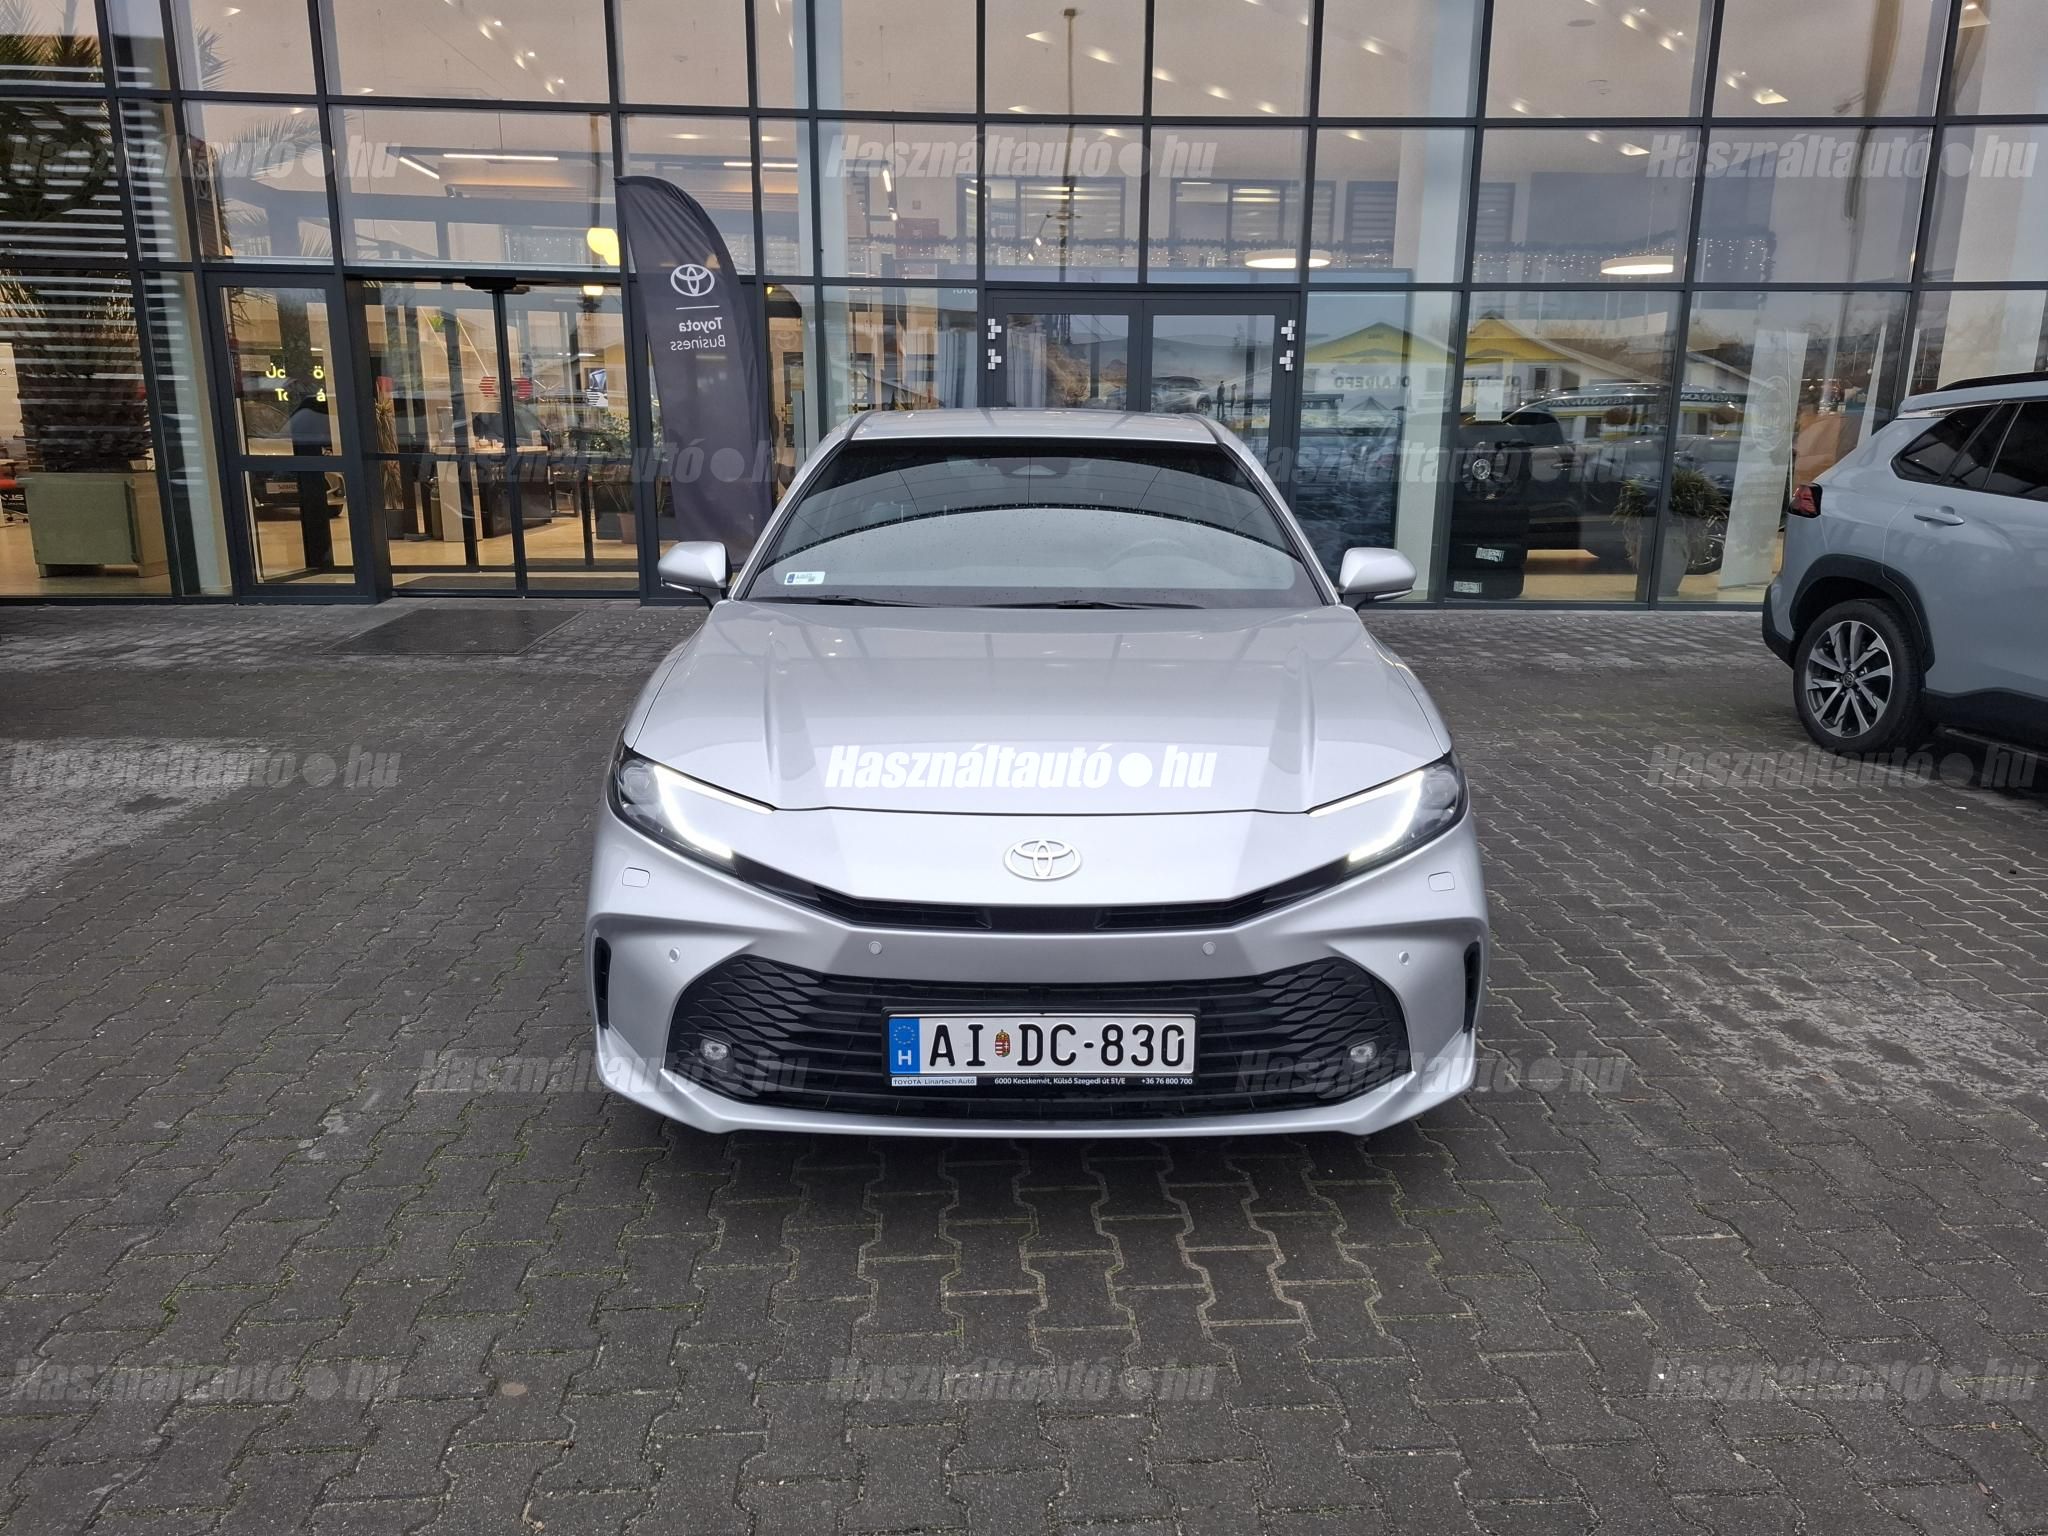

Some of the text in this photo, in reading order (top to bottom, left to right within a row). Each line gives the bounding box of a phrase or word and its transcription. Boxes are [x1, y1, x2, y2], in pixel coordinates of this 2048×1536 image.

[898, 1050, 912, 1066] H
[1013, 1078, 1052, 1086] Kecskemét,
[1053, 1077, 1073, 1085] Külső
[1073, 1078, 1101, 1086] Szegedi
[1101, 1077, 1109, 1085] út
